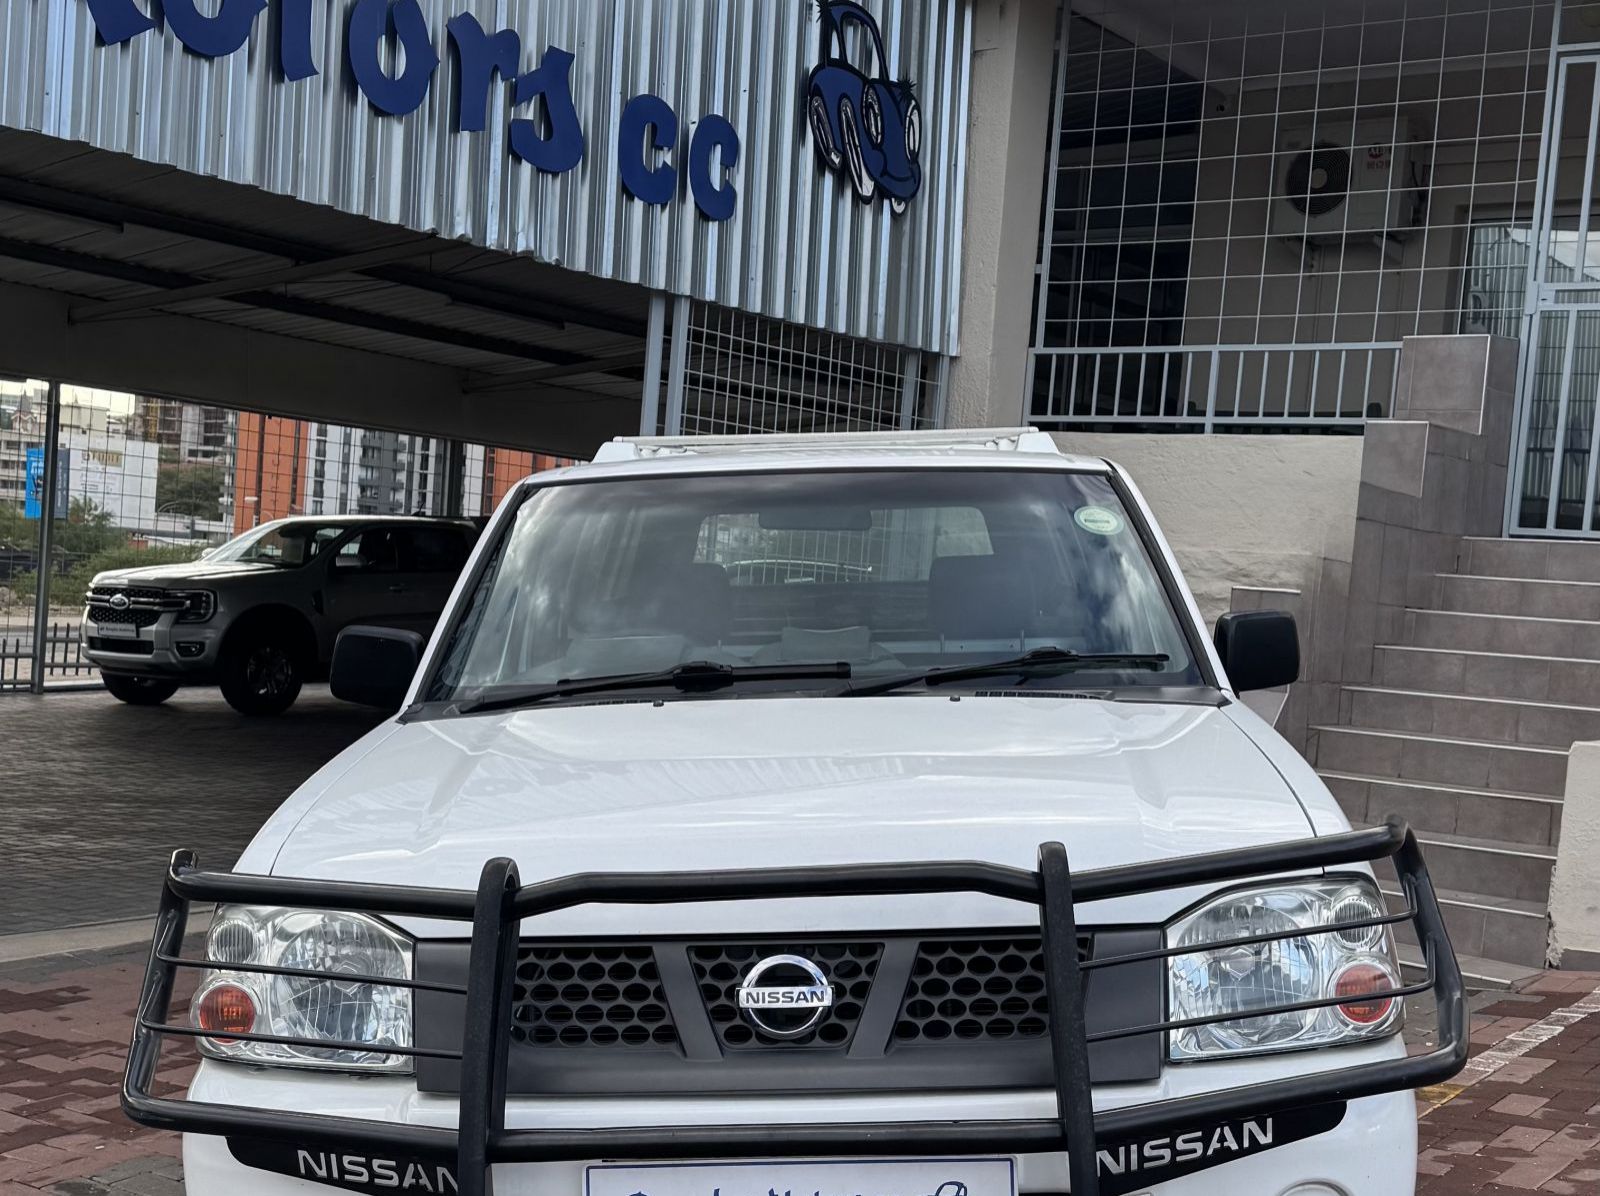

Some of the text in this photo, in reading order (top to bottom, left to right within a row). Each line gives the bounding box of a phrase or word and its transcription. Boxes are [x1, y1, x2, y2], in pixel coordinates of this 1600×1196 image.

[87, 0, 584, 173] tors
[745, 990, 825, 1005] NISSAN
[296, 1149, 458, 1195] NISSAN
[1096, 1117, 1273, 1177] NISSAN
